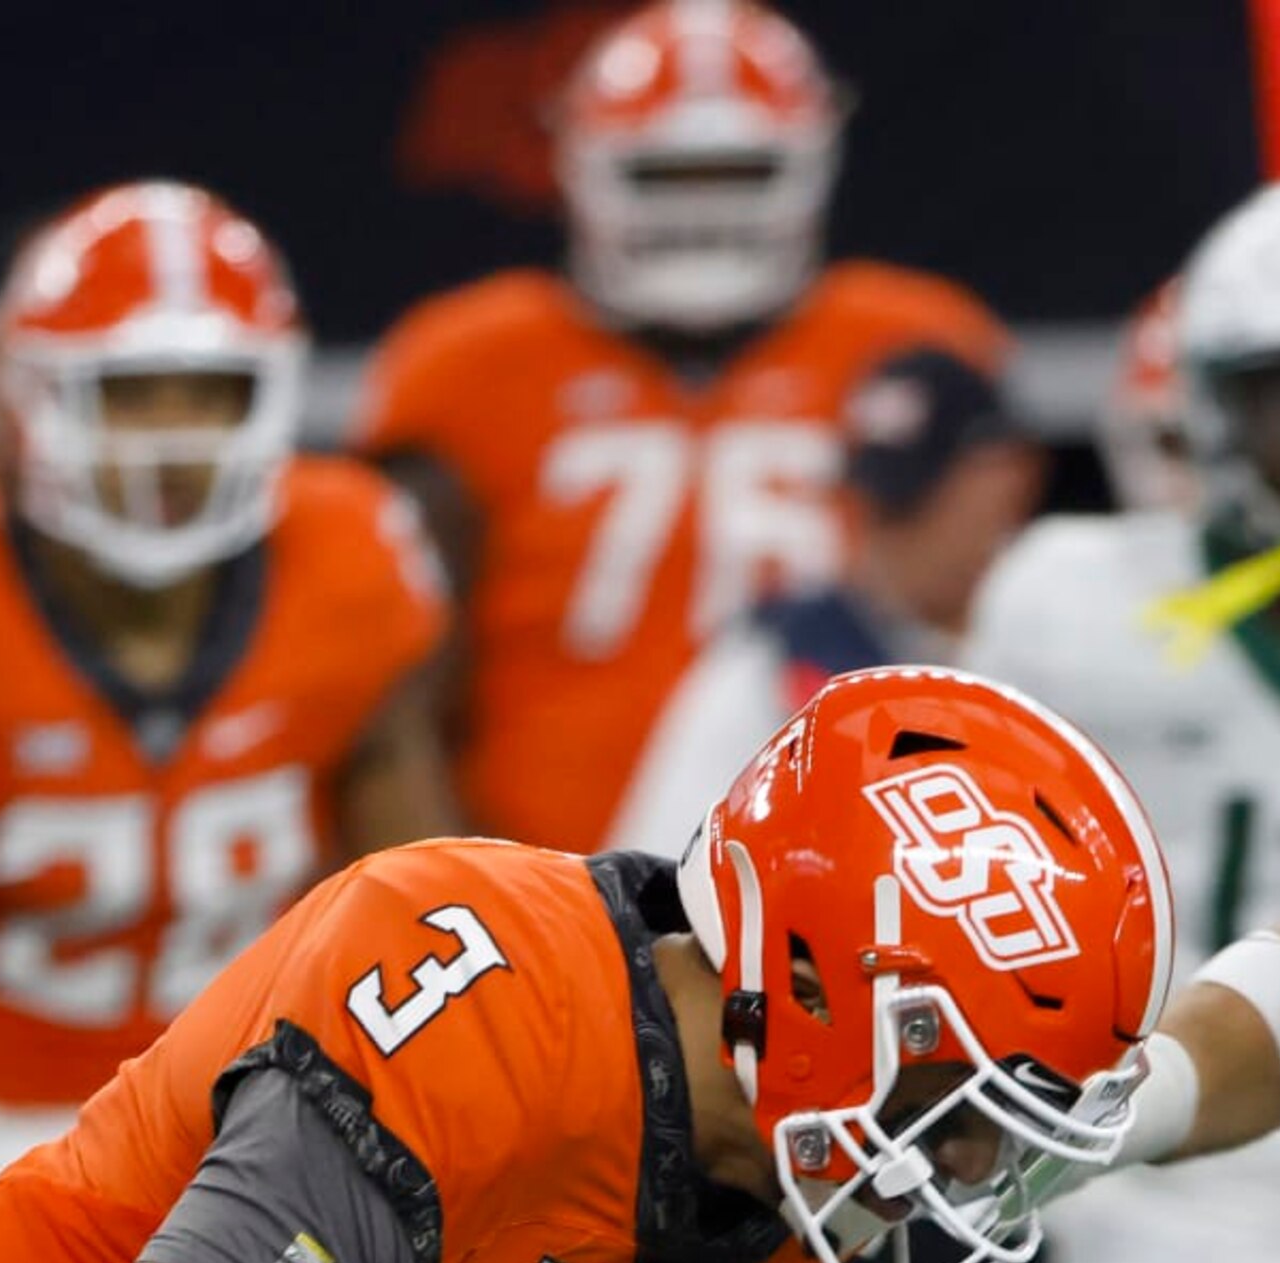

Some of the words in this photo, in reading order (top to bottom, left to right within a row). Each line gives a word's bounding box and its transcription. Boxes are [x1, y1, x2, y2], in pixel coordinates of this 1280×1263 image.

[537, 420, 840, 663] 76
[861, 763, 1081, 971] OSU
[347, 904, 511, 1057] 3
